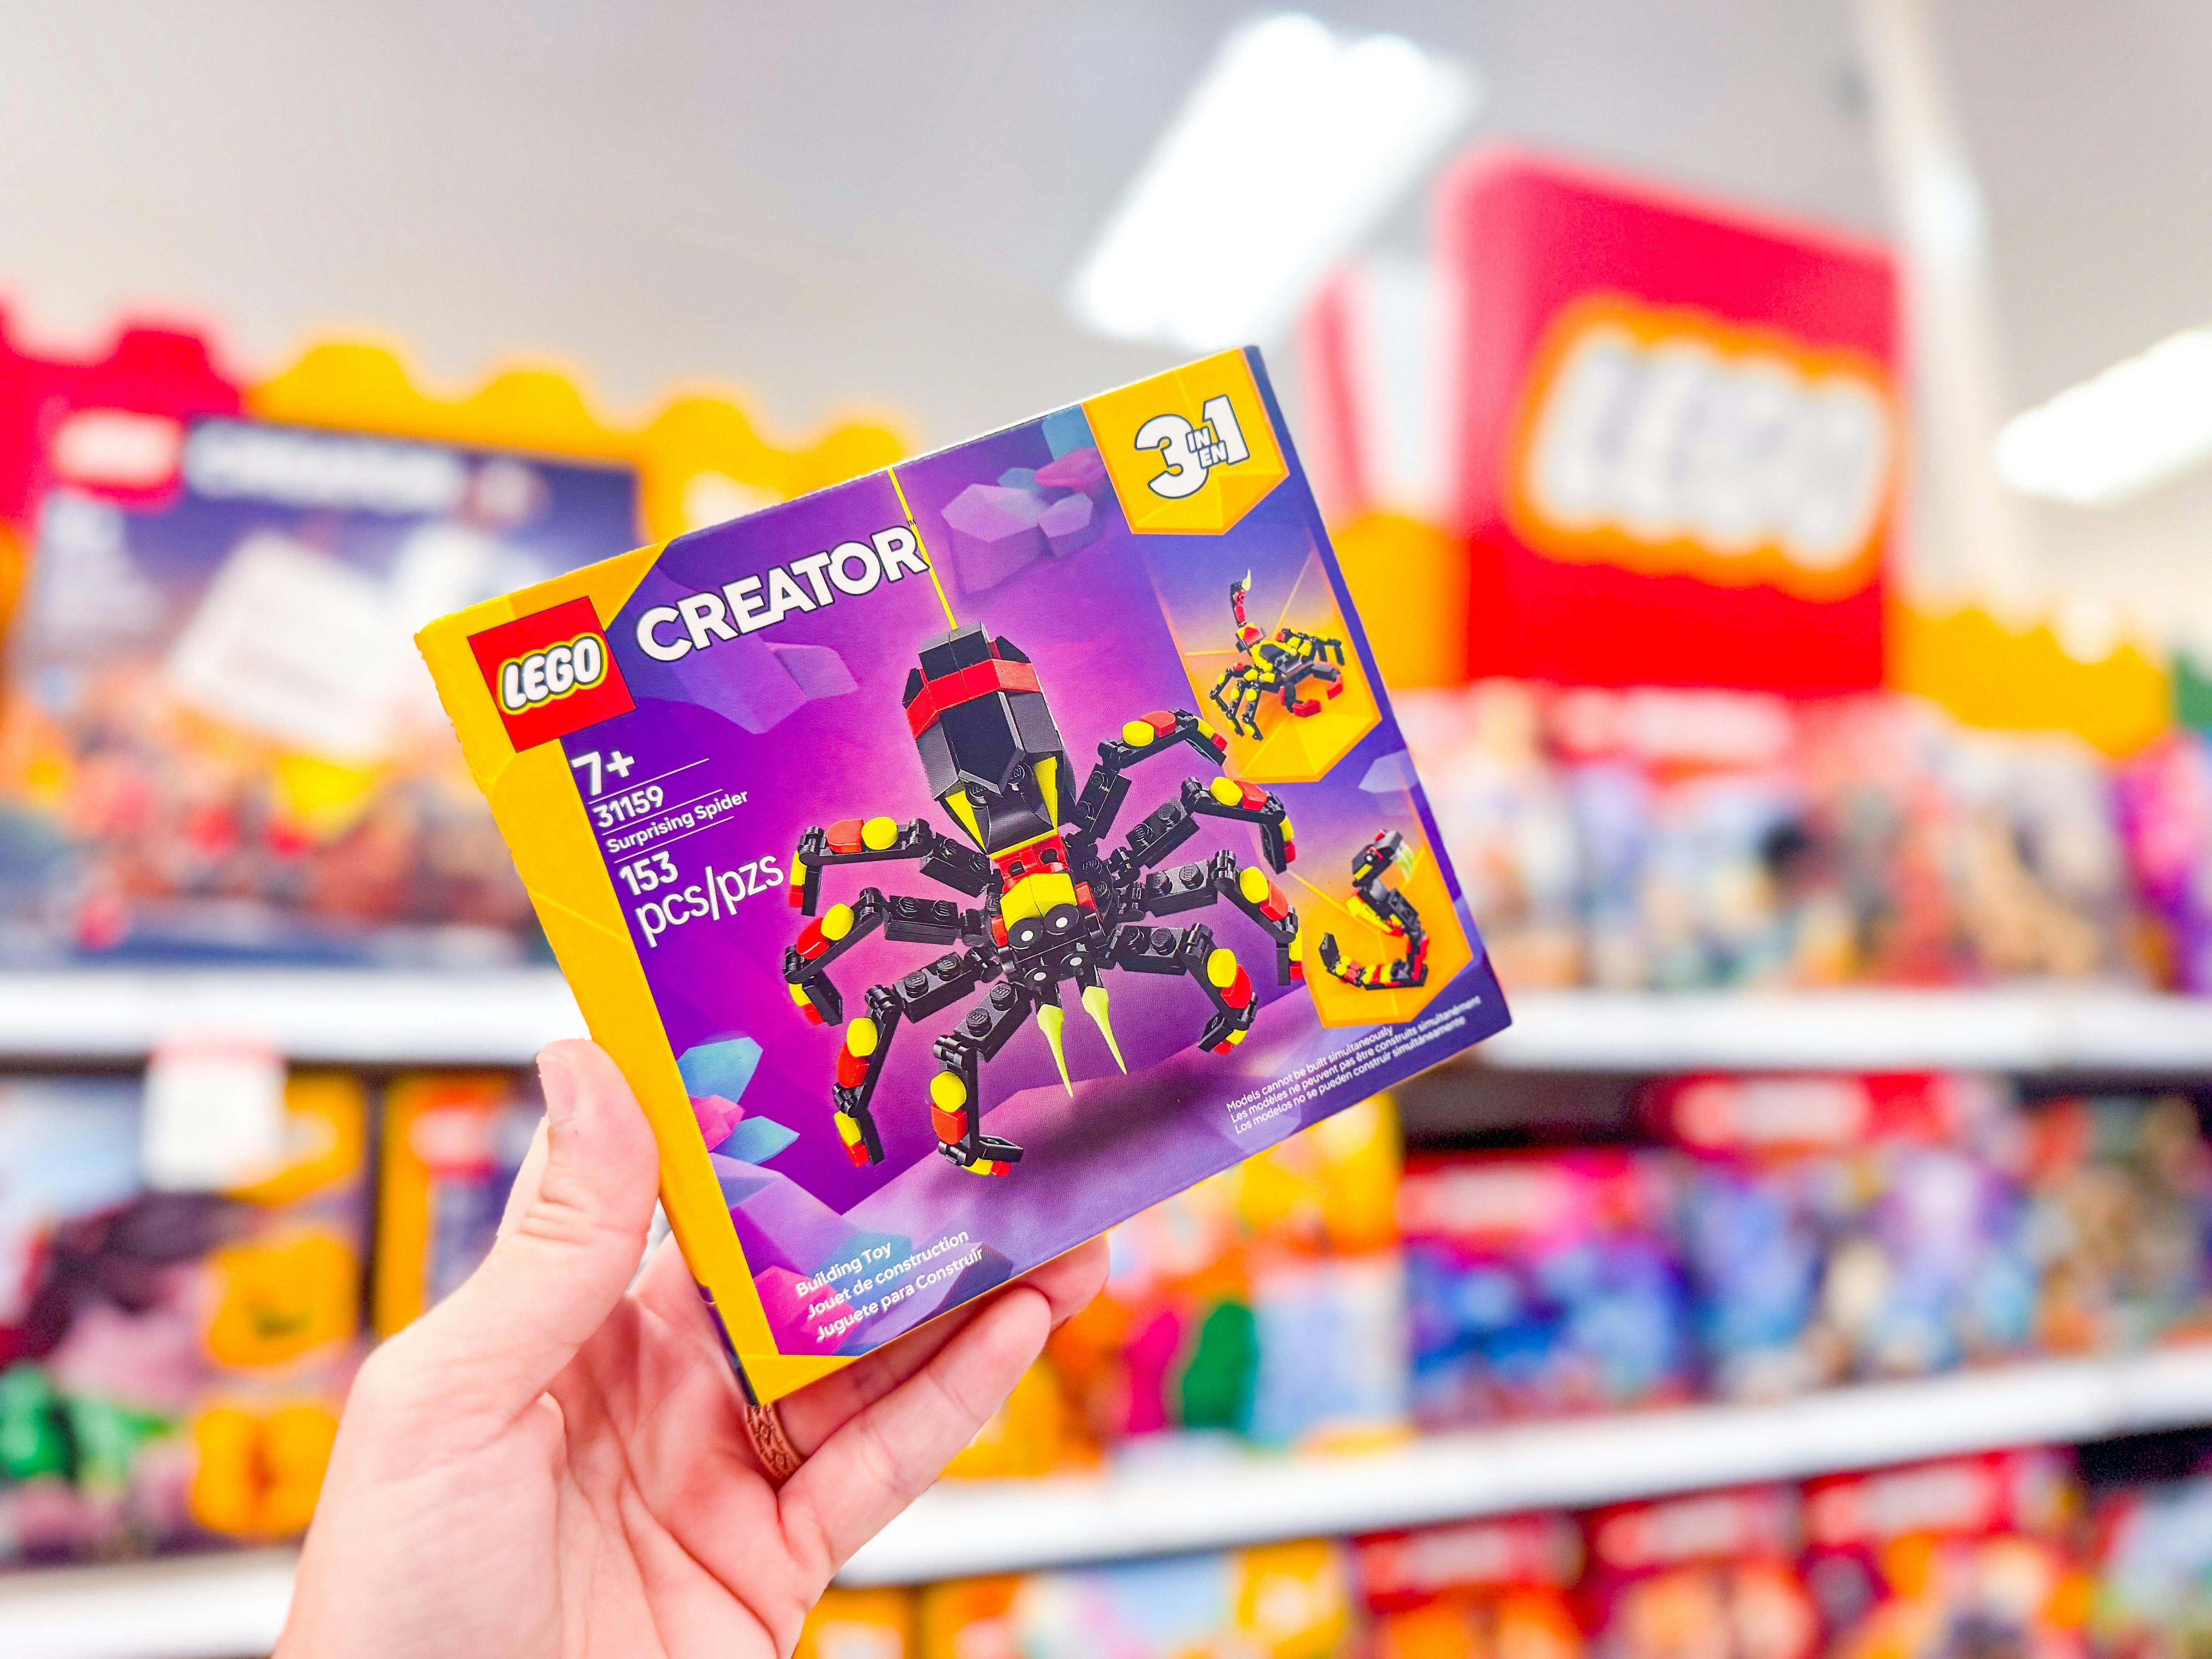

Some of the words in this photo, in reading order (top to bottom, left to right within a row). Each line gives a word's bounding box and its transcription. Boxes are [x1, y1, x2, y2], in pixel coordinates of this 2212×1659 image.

[1135, 414, 1209, 499] 3
[1186, 427, 1212, 452] IN
[1202, 394, 1250, 466] 1
[1199, 441, 1228, 468] EN
[636, 525, 930, 662] CREATOR
[500, 636, 603, 710] LEGO
[570, 750, 635, 796] 7+
[593, 786, 663, 828] 31159
[608, 811, 695, 853] Surprising
[694, 791, 748, 820] Spider
[620, 850, 678, 896] 153
[635, 855, 784, 948] pcs/pzs
[1226, 1091, 1261, 1112] Models
[1262, 1073, 1293, 1095] cannot
[1293, 1068, 1306, 1080] be
[1306, 1056, 1328, 1073] built
[1328, 1025, 1393, 1063] simultaneously
[1230, 1109, 1248, 1123] Les
[1248, 1089, 1288, 1114] modèles
[1288, 1084, 1300, 1096] ne
[1301, 1064, 1339, 1091] peuvent
[1339, 1057, 1355, 1072] pas
[1356, 1048, 1374, 1062] être
[1375, 1026, 1418, 1053] construits
[1235, 1120, 1252, 1134] Los
[1253, 1099, 1293, 1125] modelos
[1293, 1094, 1306, 1106] no
[1306, 1088, 1317, 1099] se
[1318, 1070, 1353, 1096] pueden
[1353, 1051, 1391, 1076] construir
[795, 1257, 862, 1297] Building
[861, 1242, 891, 1263] Toy
[808, 1288, 852, 1319] Jouet
[853, 1279, 873, 1295] de
[875, 1231, 969, 1284] construction
[816, 1302, 879, 1341] Juguete
[881, 1284, 915, 1312] para
[916, 1248, 983, 1289] Construir
